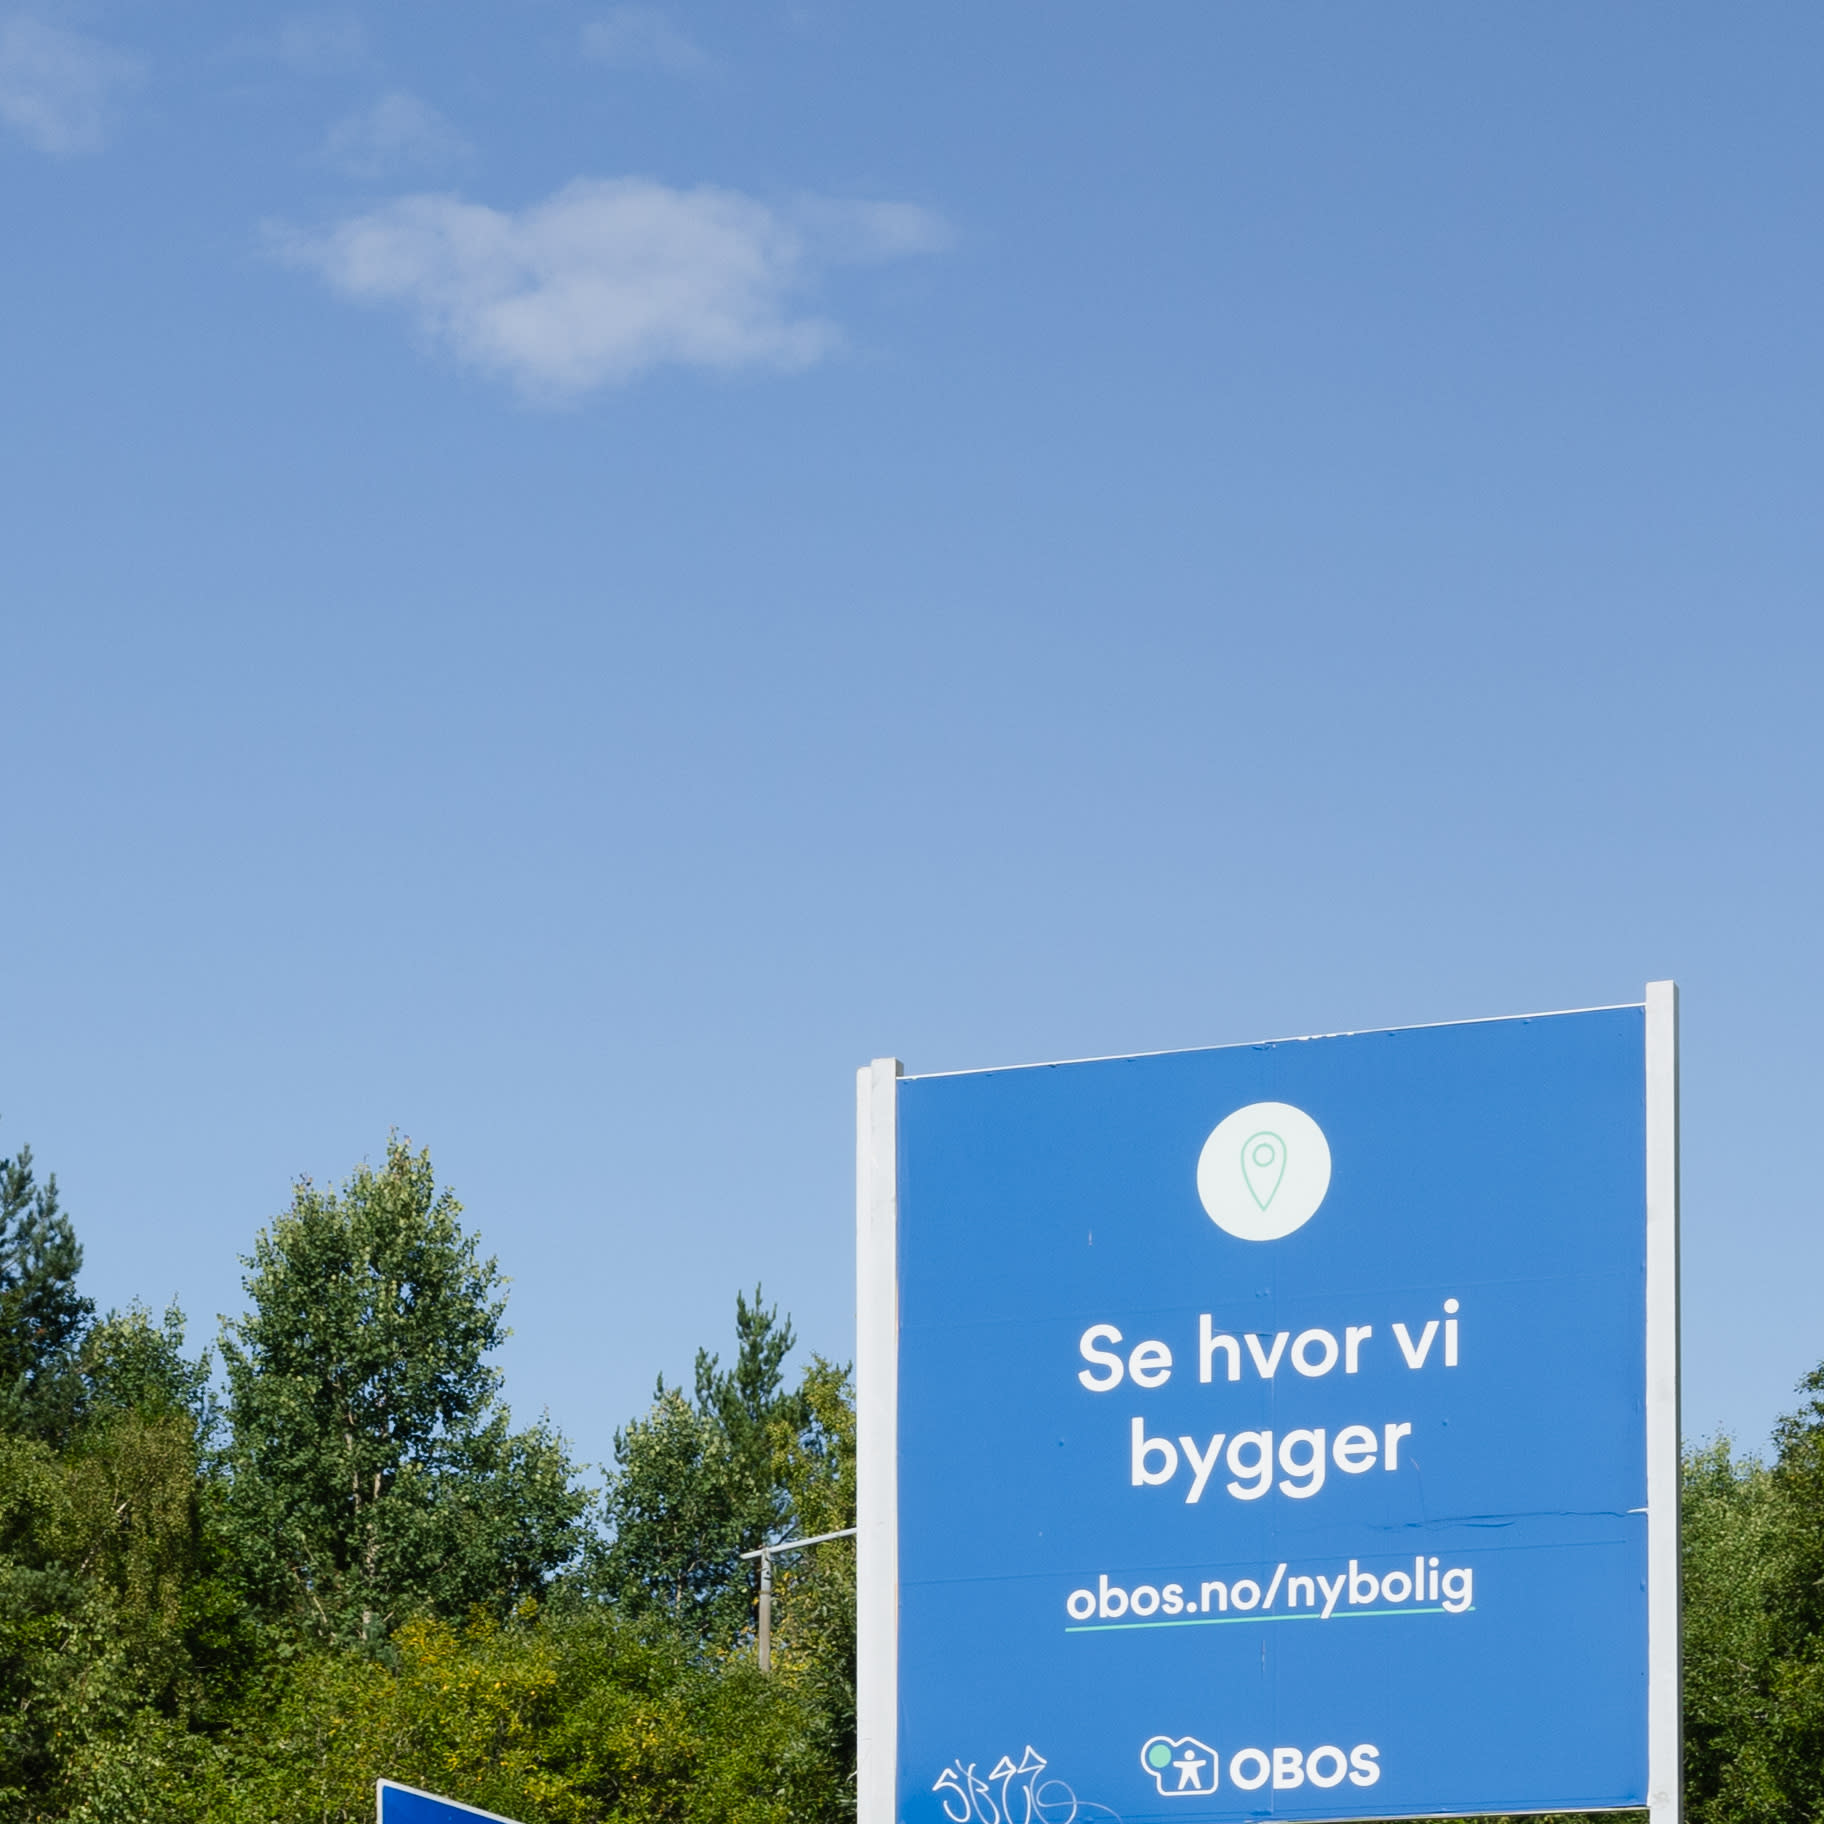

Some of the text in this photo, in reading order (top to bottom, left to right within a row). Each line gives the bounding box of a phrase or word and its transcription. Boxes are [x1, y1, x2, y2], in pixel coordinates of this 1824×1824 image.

[1078, 1299, 1460, 1393] Se hvor vi
[1131, 1417, 1412, 1504] bygger
[1066, 1557, 1474, 1620] obos.no/nybolig
[1230, 1744, 1381, 1790] OBOS
